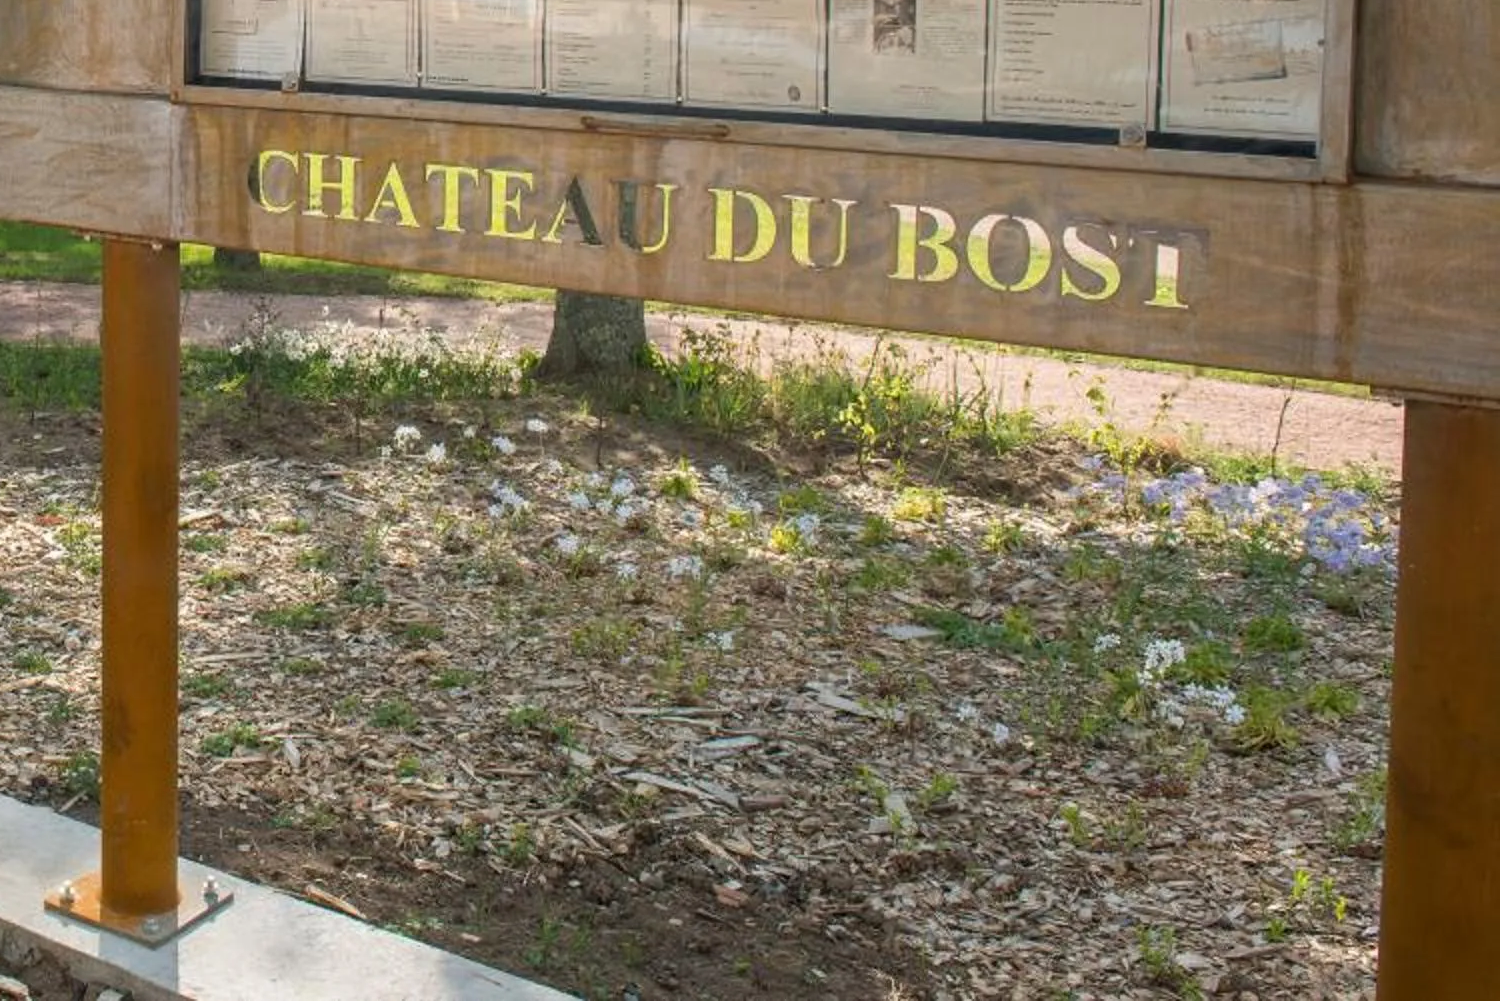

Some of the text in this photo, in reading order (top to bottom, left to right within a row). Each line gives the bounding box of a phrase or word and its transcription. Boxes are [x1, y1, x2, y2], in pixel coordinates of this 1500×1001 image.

[247, 149, 1210, 311] CHATEAU DU BOST
